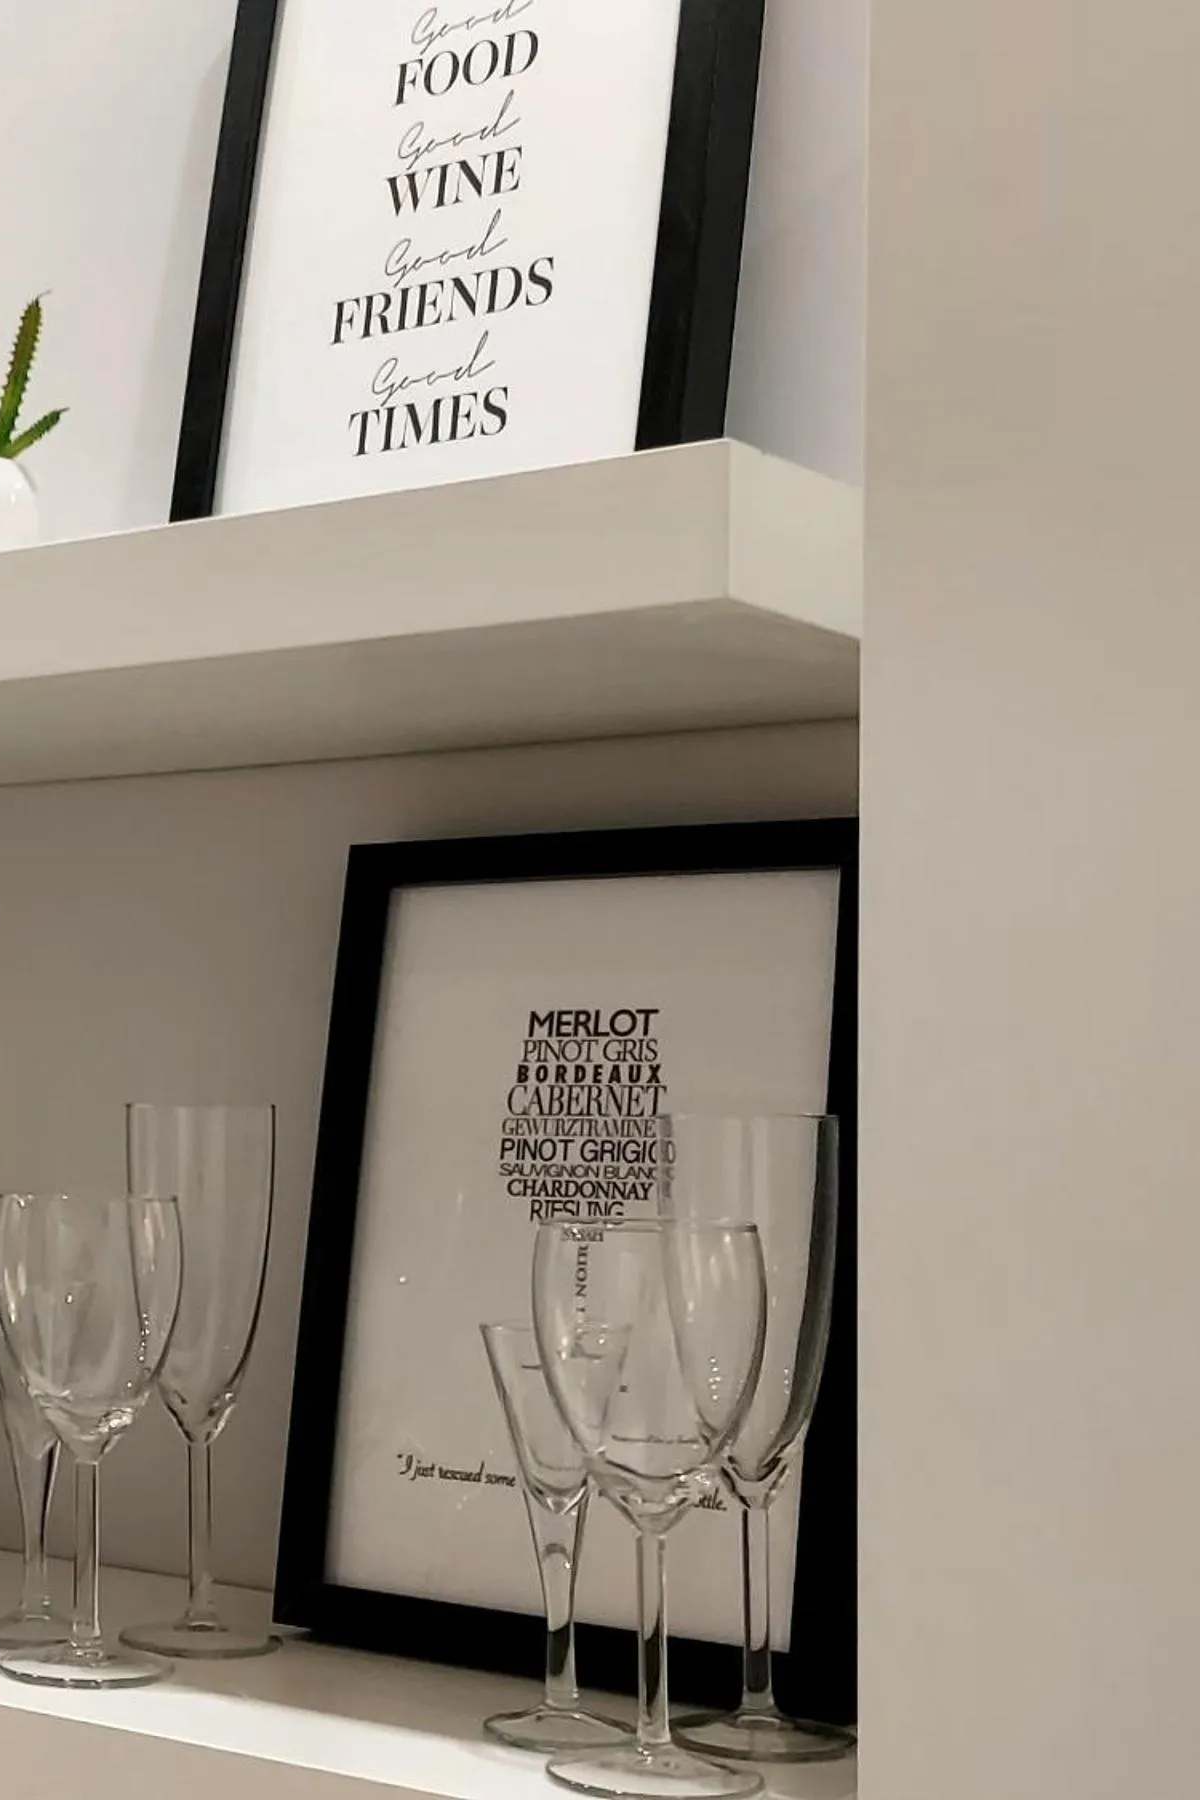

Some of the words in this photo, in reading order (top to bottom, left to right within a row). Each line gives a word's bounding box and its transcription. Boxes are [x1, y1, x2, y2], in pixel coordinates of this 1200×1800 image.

[411, 0, 534, 52] Good
[392, 28, 540, 108] FOOD
[397, 89, 522, 171] Good
[385, 144, 524, 218] WINE
[384, 208, 509, 287] Good
[329, 256, 556, 346] FRIENDS
[370, 330, 497, 407] Good
[347, 386, 510, 458] TIMES
[527, 1008, 660, 1038] MERLOT
[521, 1039, 599, 1064] PINOT
[602, 1038, 659, 1063] GRIS
[516, 1064, 662, 1084] BORDEAUX
[507, 1083, 668, 1118] CABERNET
[499, 1137, 575, 1162] PINOT
[499, 1162, 601, 1179] SAUVIGNON
[506, 1178, 655, 1201] CHARDONNAY
[529, 1199, 625, 1222] RIESLING
[484, 1473, 517, 1488] some
